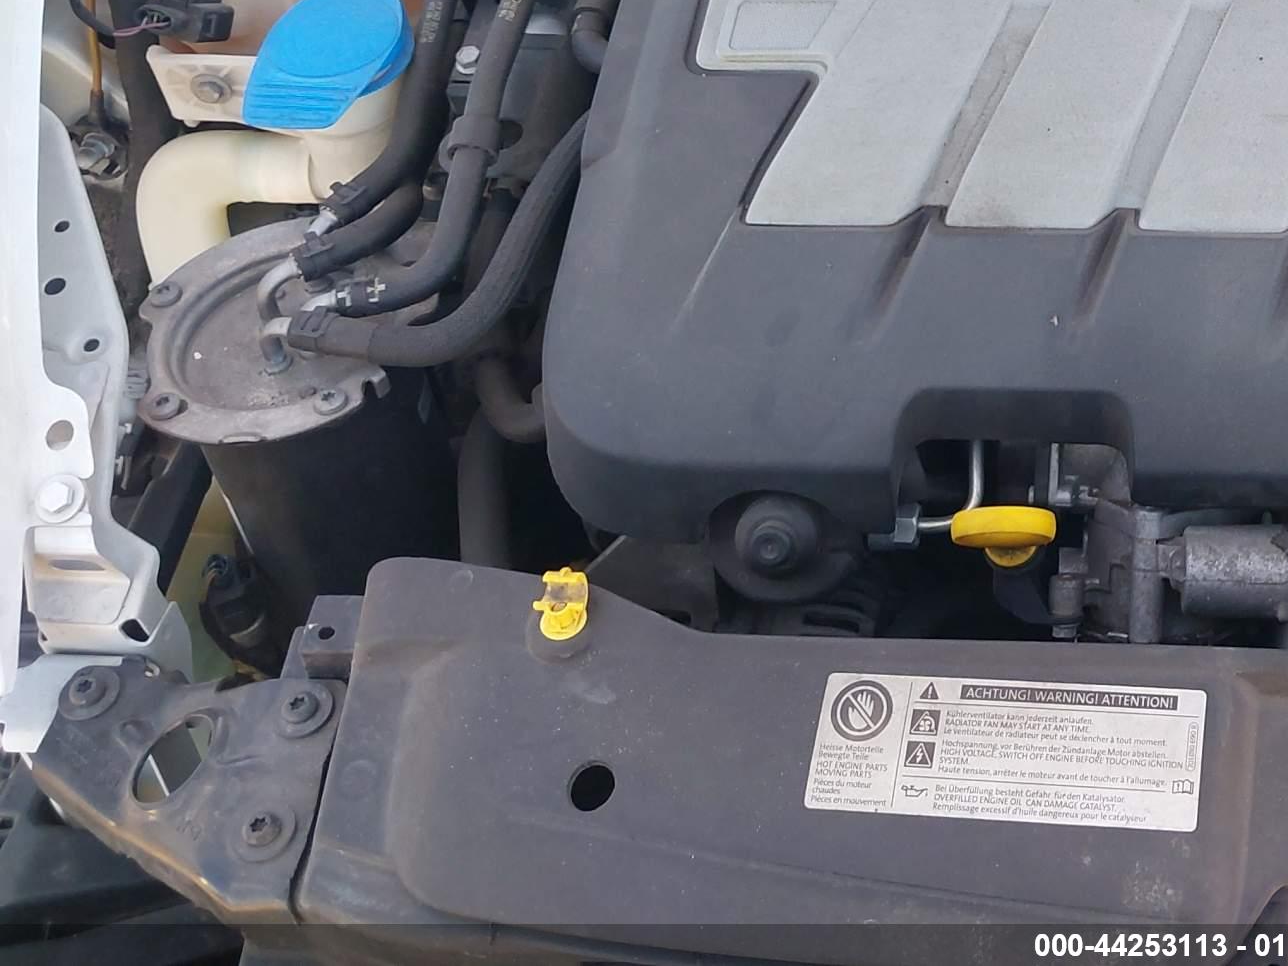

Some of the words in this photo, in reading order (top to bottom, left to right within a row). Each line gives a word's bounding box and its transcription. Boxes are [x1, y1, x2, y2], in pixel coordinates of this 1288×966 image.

[966, 687, 1030, 700] ACHTUNG!
[1035, 690, 1098, 704] WARNING!
[1102, 694, 1173, 708] ATTENTION!
